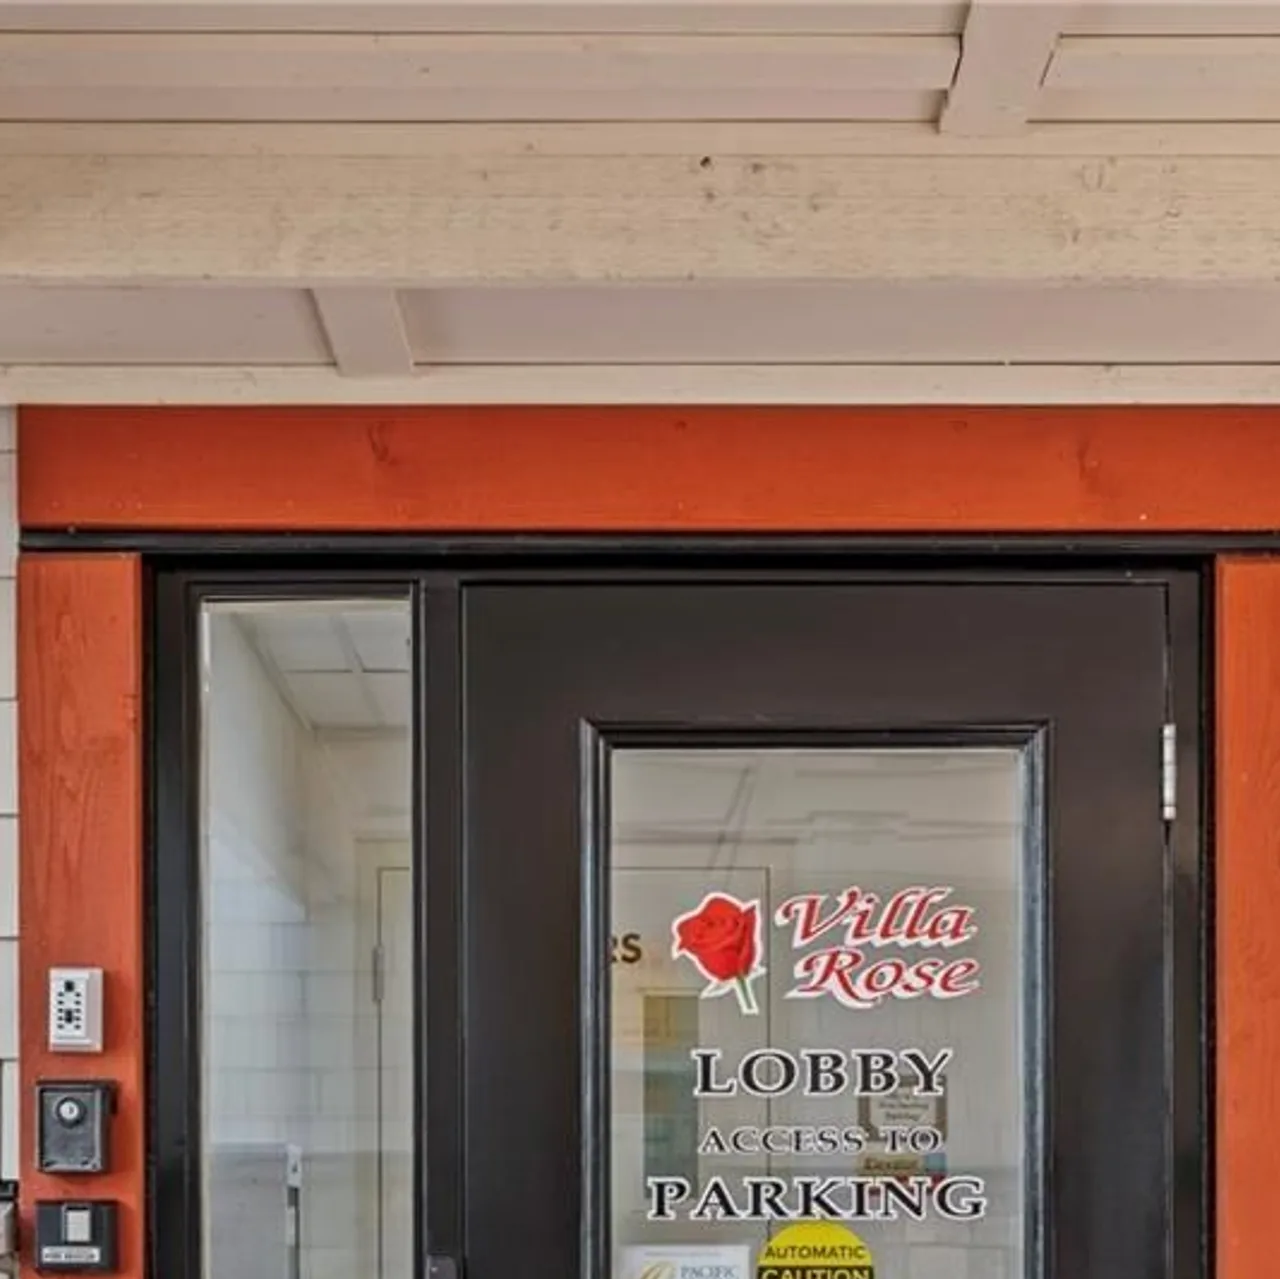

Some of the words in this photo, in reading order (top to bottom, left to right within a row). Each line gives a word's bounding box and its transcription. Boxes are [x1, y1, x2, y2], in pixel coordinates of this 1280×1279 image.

[777, 886, 978, 948] Villa
[786, 947, 981, 1007] Rose
[694, 1049, 953, 1098] LOBBY
[699, 1126, 865, 1155] ACCESS
[883, 1126, 943, 1155] TO
[648, 1176, 988, 1221] PARKING
[764, 1244, 866, 1260] AUTOMATIC
